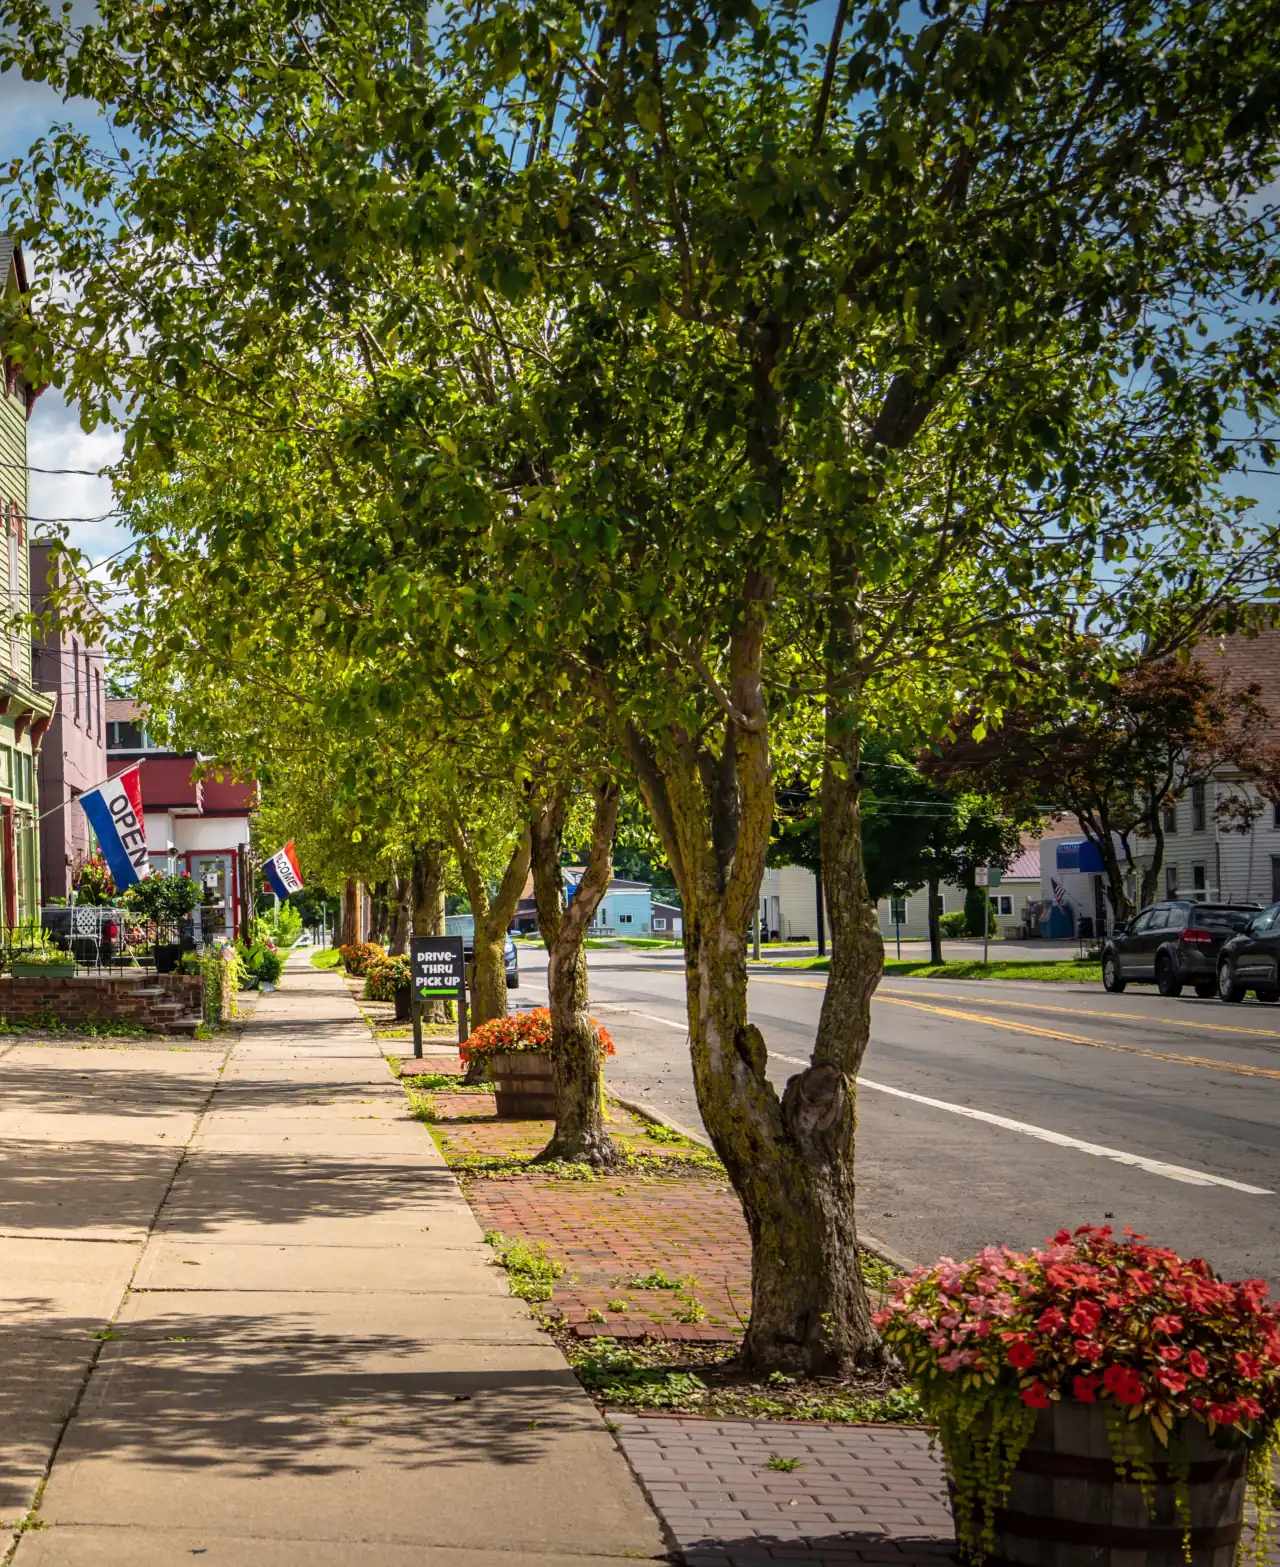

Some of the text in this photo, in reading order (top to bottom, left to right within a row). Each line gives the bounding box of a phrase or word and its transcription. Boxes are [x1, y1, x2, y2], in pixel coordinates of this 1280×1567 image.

[109, 794, 147, 868] OPEN
[421, 963, 453, 974] THRU
[415, 976, 461, 986] PICK UP
